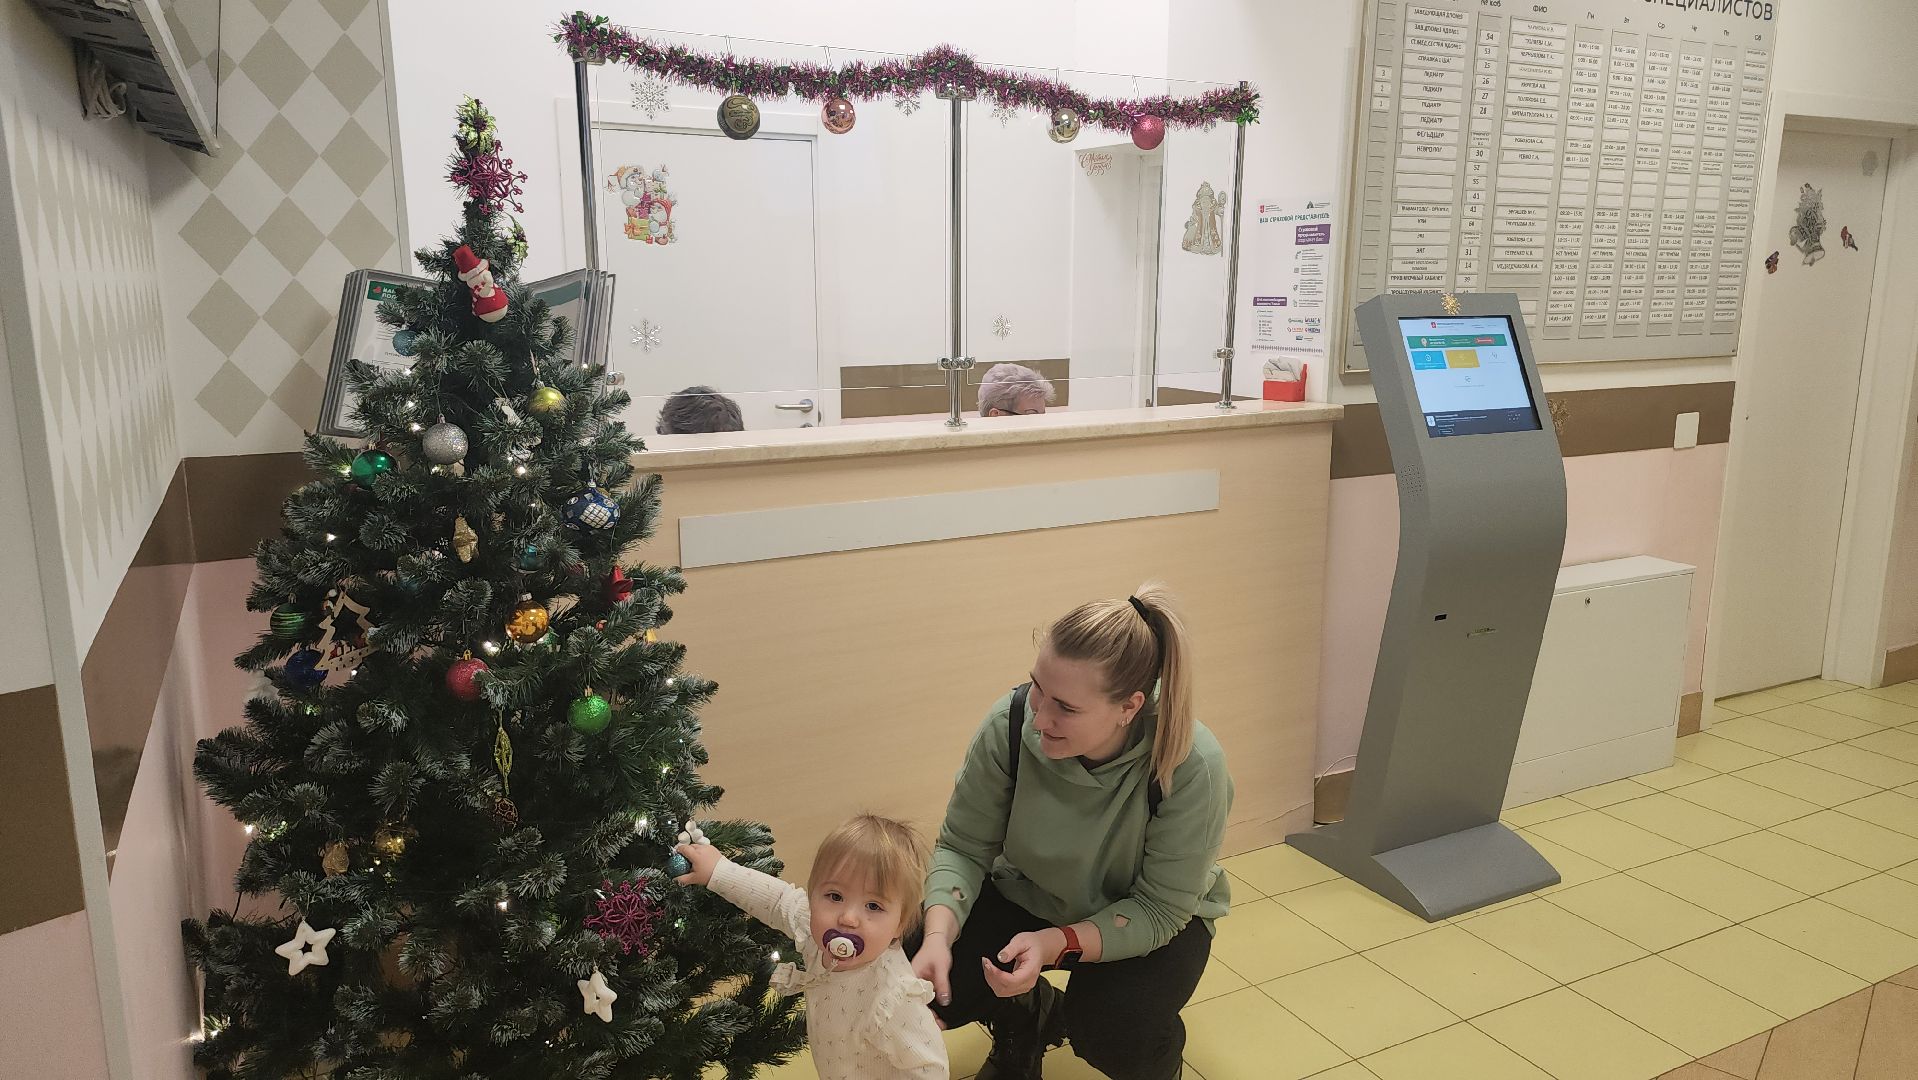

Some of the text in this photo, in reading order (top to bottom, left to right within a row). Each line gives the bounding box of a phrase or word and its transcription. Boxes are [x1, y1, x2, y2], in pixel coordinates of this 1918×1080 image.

[1532, 4, 1548, 13] ФИО
[1644, 0, 1773, 21] ЦИАЛИСТОВ
[1485, 32, 1494, 41] 54
[1475, 149, 1484, 158] 30
